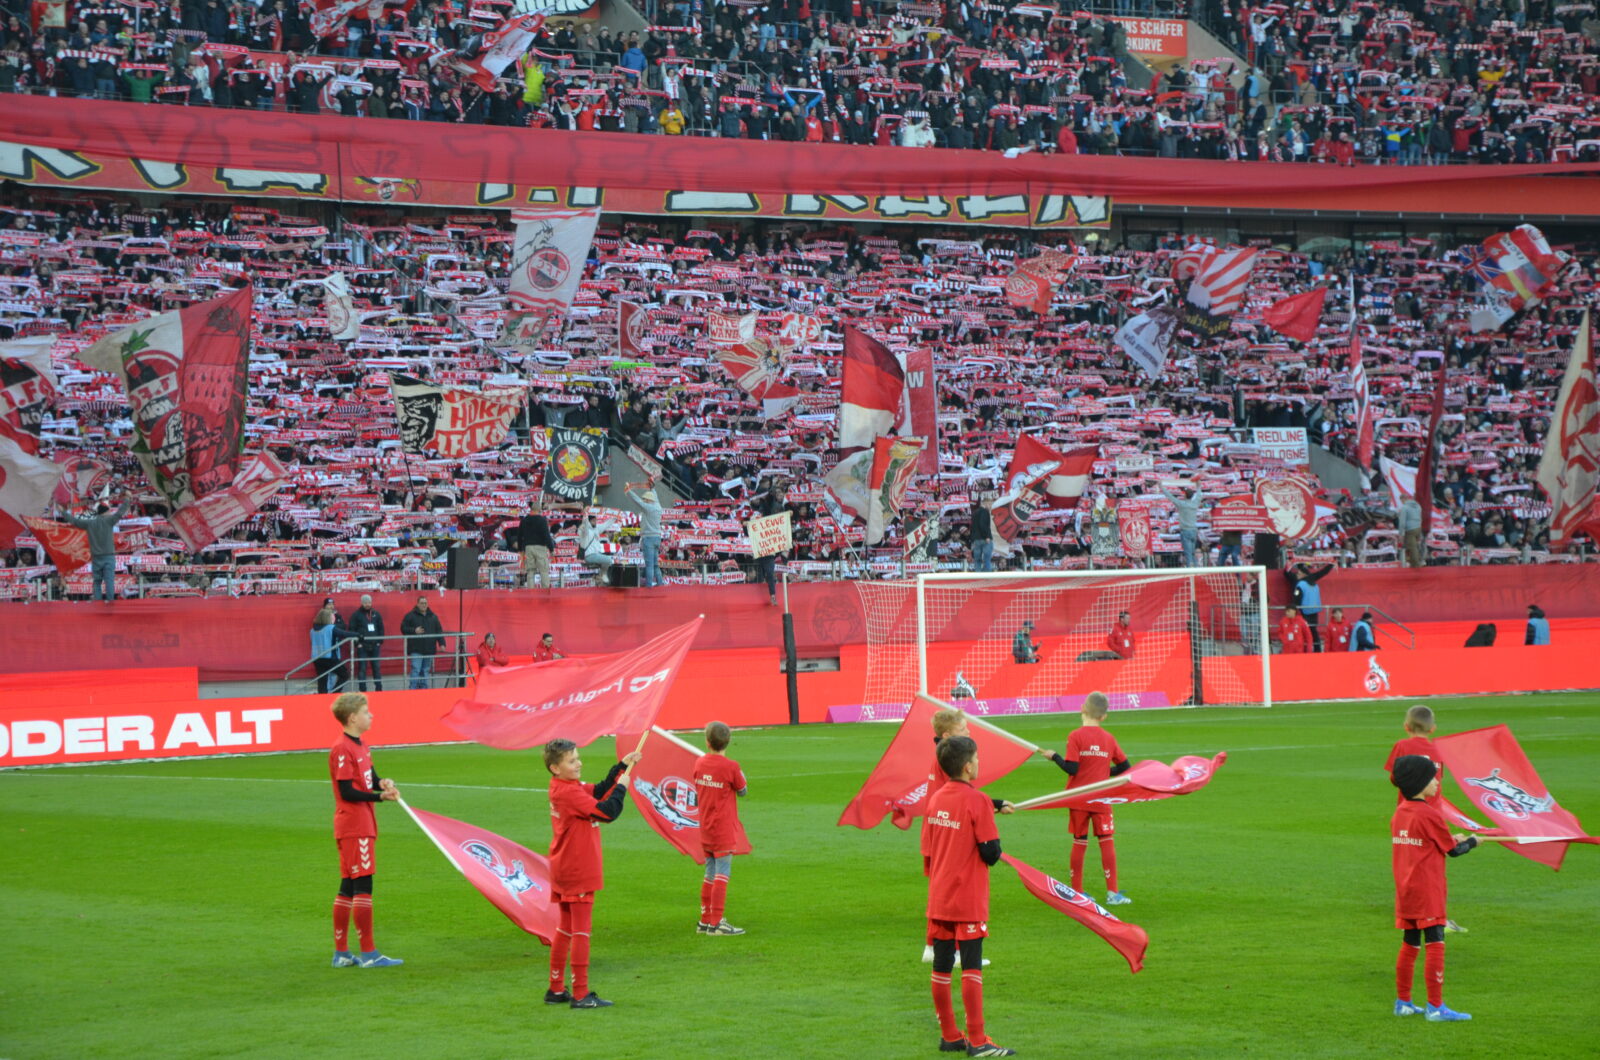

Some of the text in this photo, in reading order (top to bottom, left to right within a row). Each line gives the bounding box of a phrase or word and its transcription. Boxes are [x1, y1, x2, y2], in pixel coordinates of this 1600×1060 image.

[1140, 20, 1183, 37] SCHÄFER
[557, 430, 597, 449] JUNGE
[1257, 430, 1304, 443] REDLINE
[550, 480, 588, 500] HORDE
[0, 708, 283, 758] DER ALT
[937, 810, 950, 819] FC
